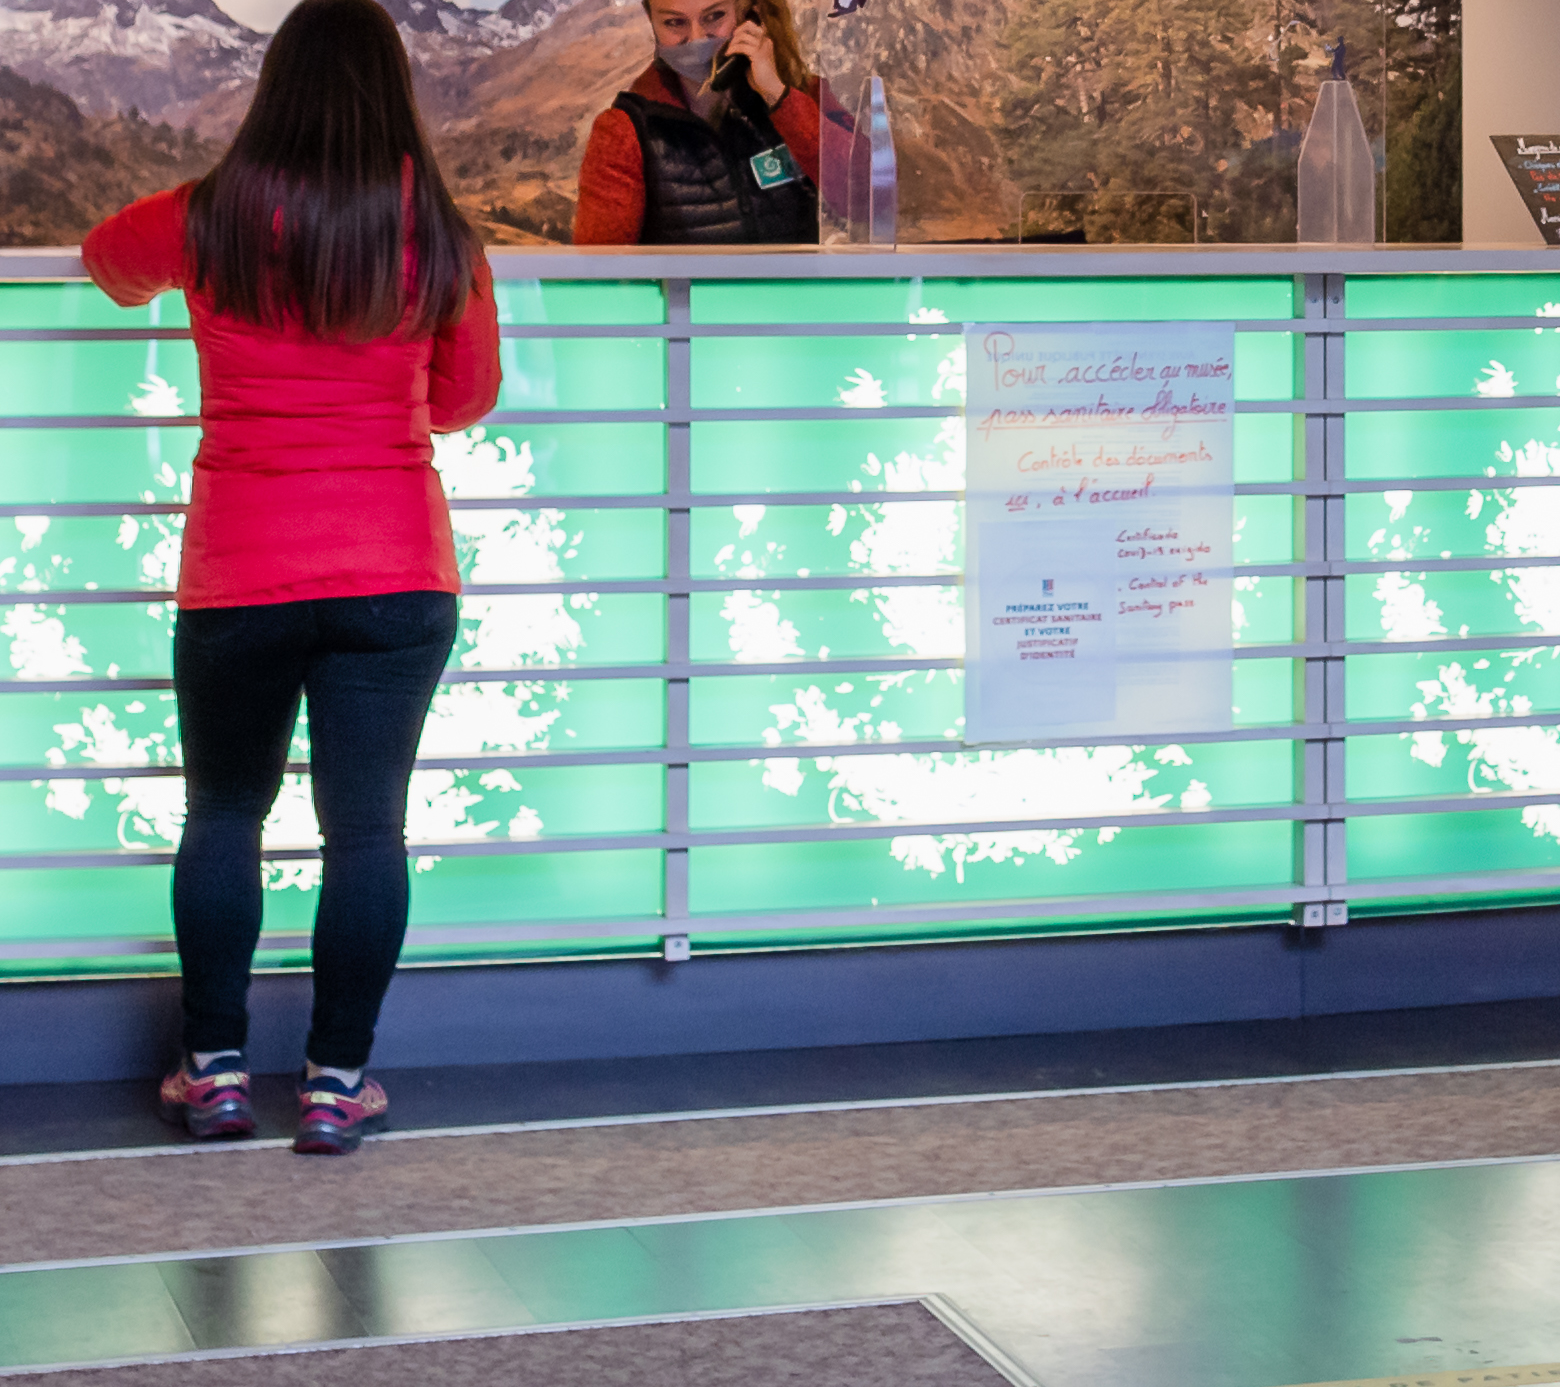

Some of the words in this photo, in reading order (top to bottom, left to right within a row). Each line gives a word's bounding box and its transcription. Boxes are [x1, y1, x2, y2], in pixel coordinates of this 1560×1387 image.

[983, 331, 1048, 392] Pour
[1057, 351, 1157, 384] accéder
[1160, 364, 1181, 379] au
[981, 407, 1037, 442] pass
[1042, 393, 1135, 424] sanitaire
[1092, 445, 1121, 468] des
[1052, 485, 1066, 506] à
[1056, 602, 1089, 611] VOTRE
[1024, 627, 1036, 637] ET
[1038, 626, 1071, 636] VOTRE
